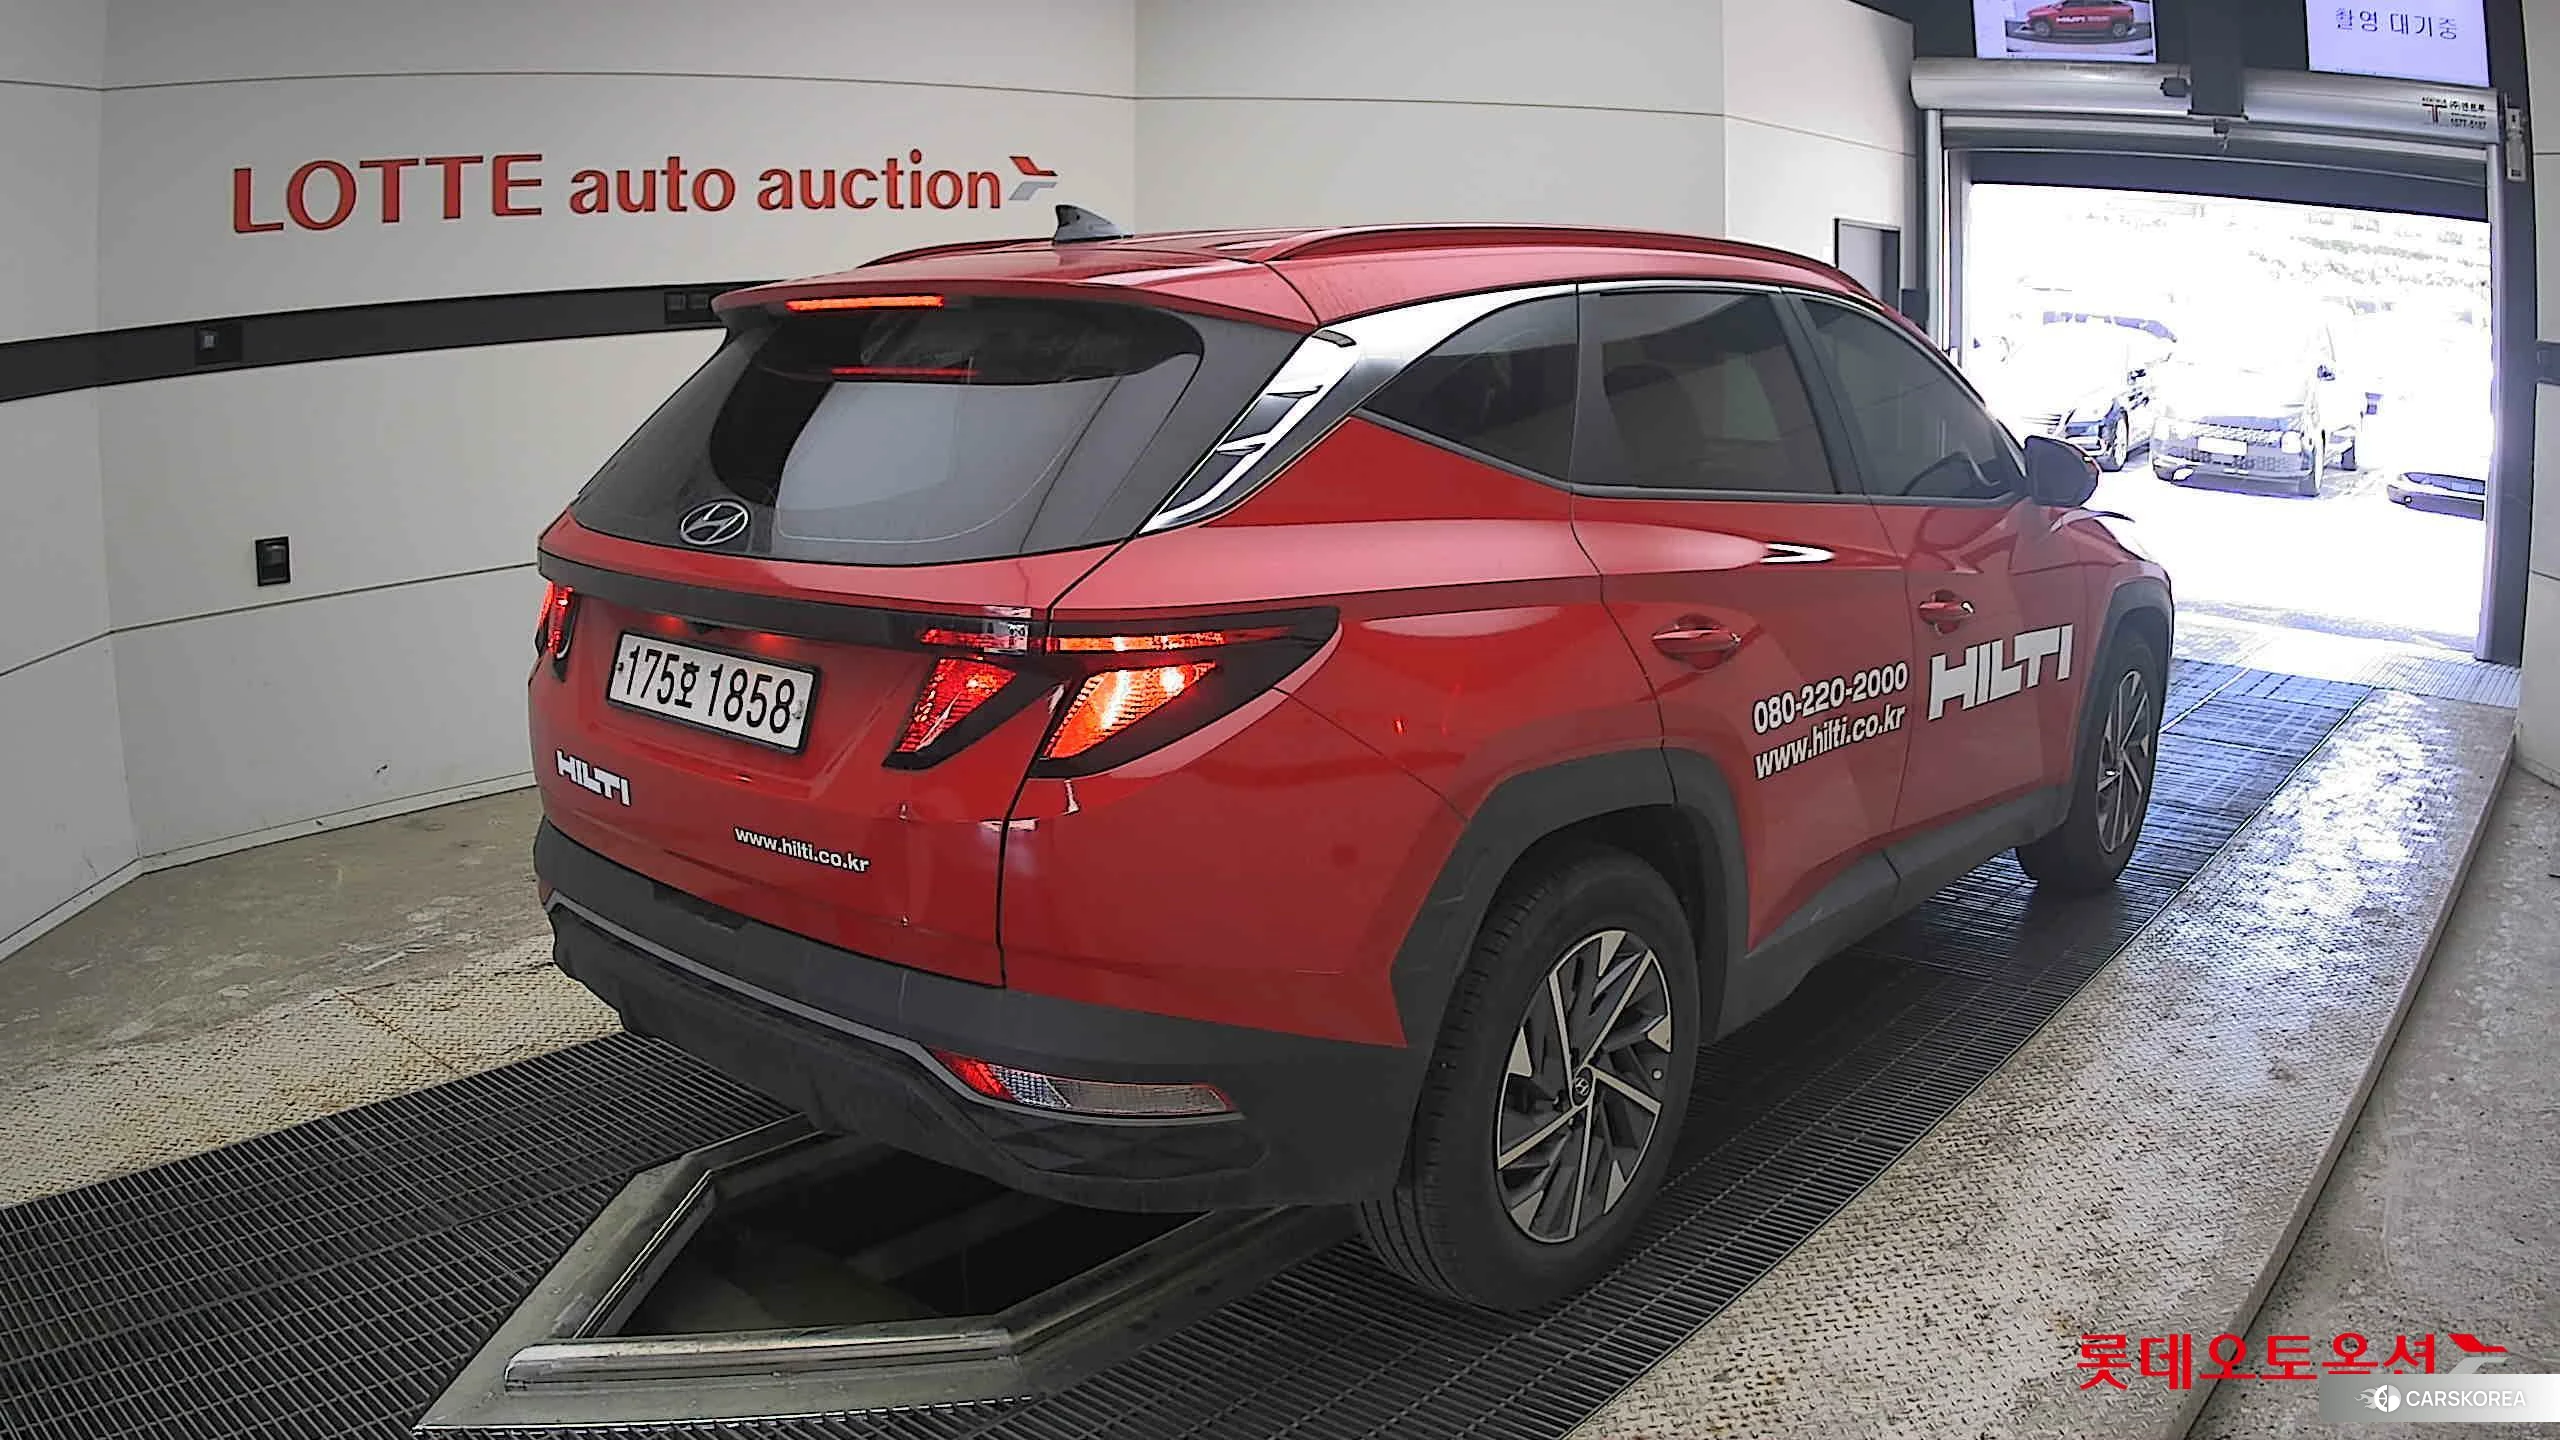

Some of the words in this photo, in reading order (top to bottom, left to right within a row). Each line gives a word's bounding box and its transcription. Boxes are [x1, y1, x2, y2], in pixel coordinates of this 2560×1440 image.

[2389, 13, 2458, 40] 대기중
[233, 154, 543, 234] LOTTE
[569, 156, 736, 213] auto
[757, 149, 1001, 209] auction
[1753, 661, 1909, 735] 080-220-2000
[1928, 624, 2073, 720] HILTI
[555, 750, 631, 806] HILTI
[1754, 703, 1907, 780] www.hilti.co.kr
[734, 826, 870, 873] www.hilti.co.kr
